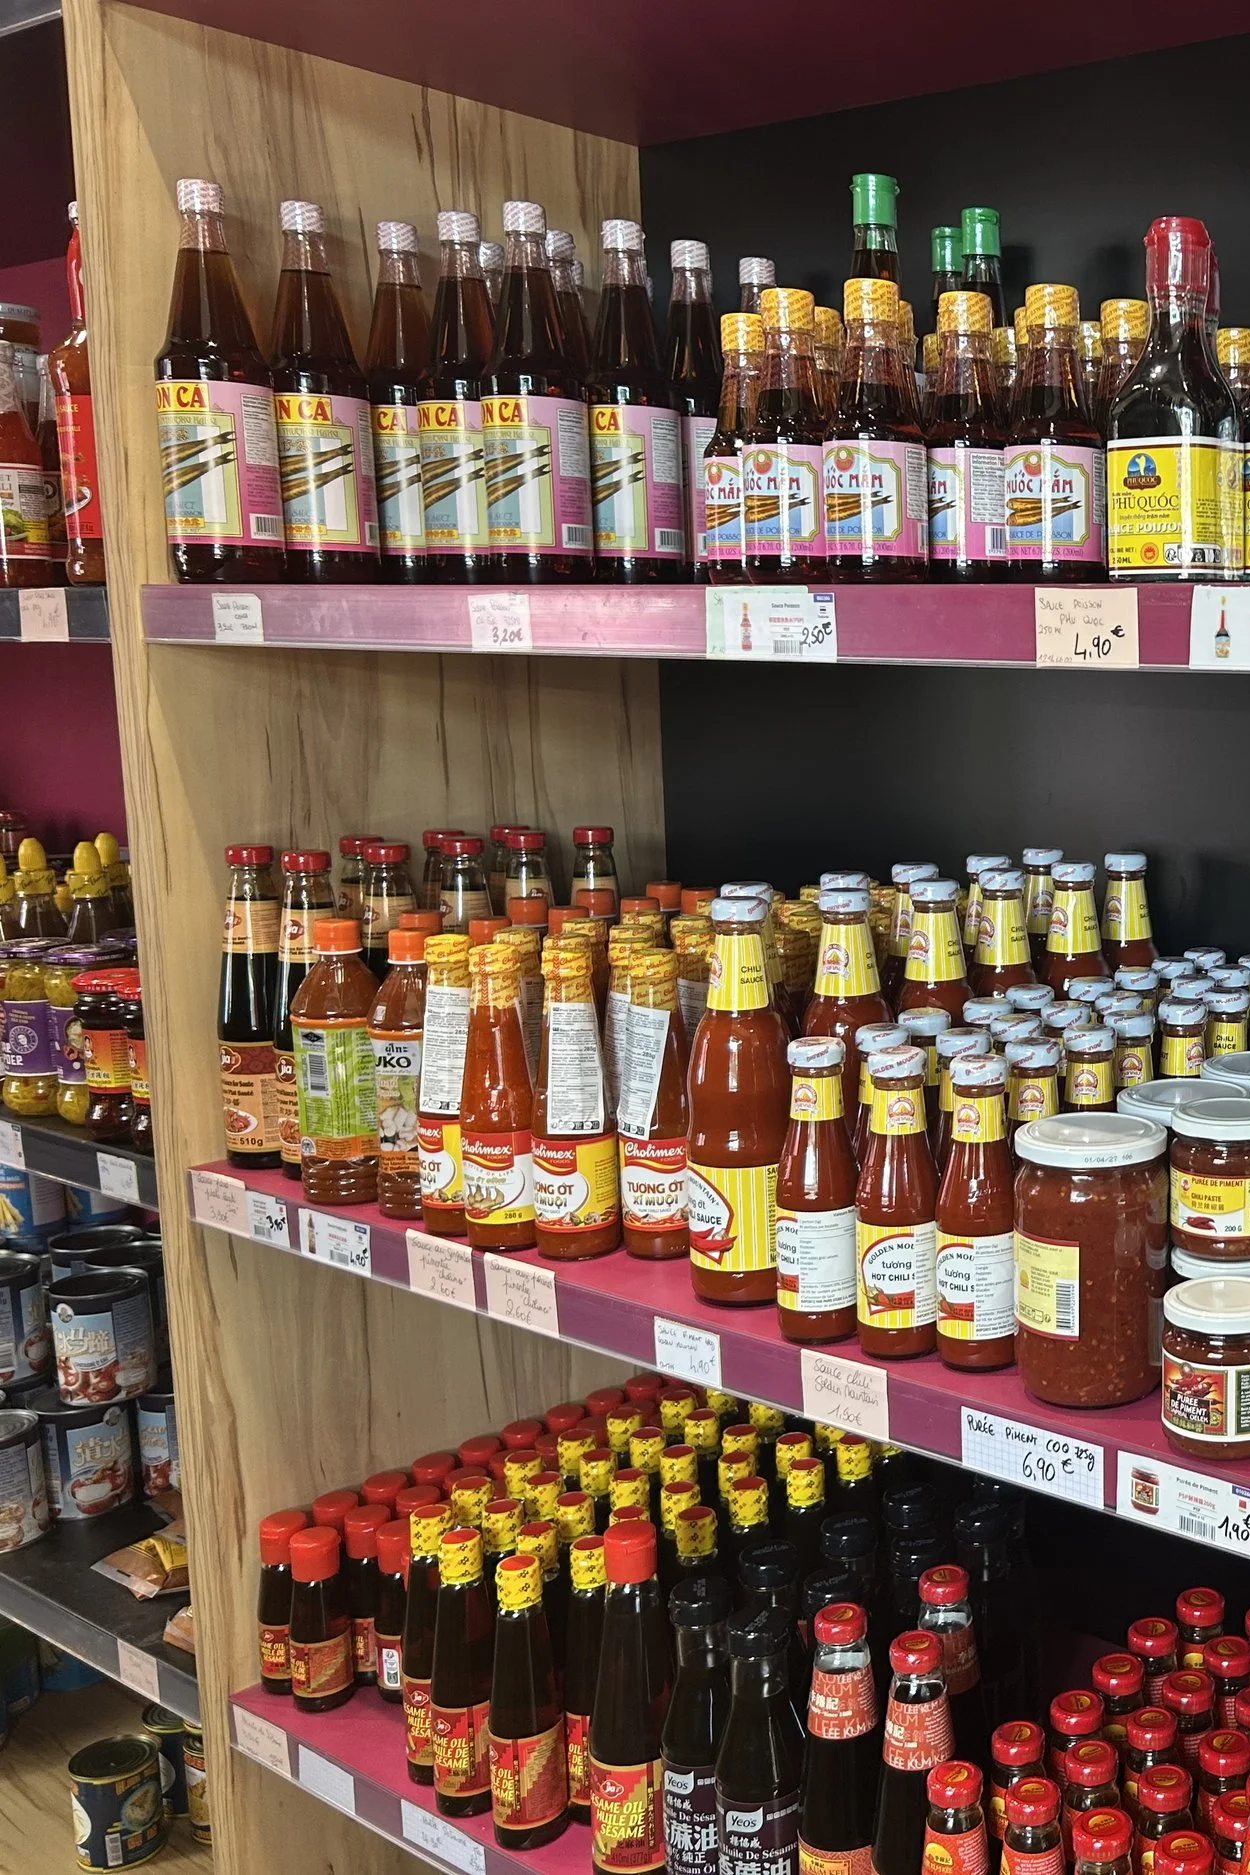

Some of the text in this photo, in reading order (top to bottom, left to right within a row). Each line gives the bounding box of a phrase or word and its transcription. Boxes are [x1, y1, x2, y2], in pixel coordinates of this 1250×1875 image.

[298, 398, 330, 421] CÁ
[500, 402, 525, 423] CÁ
[596, 409, 620, 431] CÁ
[740, 977, 764, 985] SAUCE
[240, 1138, 263, 1146] 510g
[625, 1142, 685, 1158] Cholimex
[697, 1215, 721, 1225] SAUCE
[889, 1273, 908, 1281] CHILI
[814, 1358, 842, 1380] Sauce
[1179, 1402, 1207, 1416] PIMENT
[967, 1414, 995, 1436] PURÉE
[1176, 1477, 1191, 1487] Purée
[822, 1725, 866, 1738] LEE KUM
[450, 1737, 468, 1748] OIL
[456, 1748, 468, 1758] DE
[889, 1755, 932, 1770] LEE KUM
[498, 1768, 514, 1780] OIL
[502, 1779, 514, 1789] DE
[668, 1775, 688, 1790] Yeo's
[623, 1801, 645, 1814] OIL
[597, 1811, 646, 1826] HUILE DE
[731, 1814, 757, 1829] Yeo's
[746, 1850, 759, 1860] De
